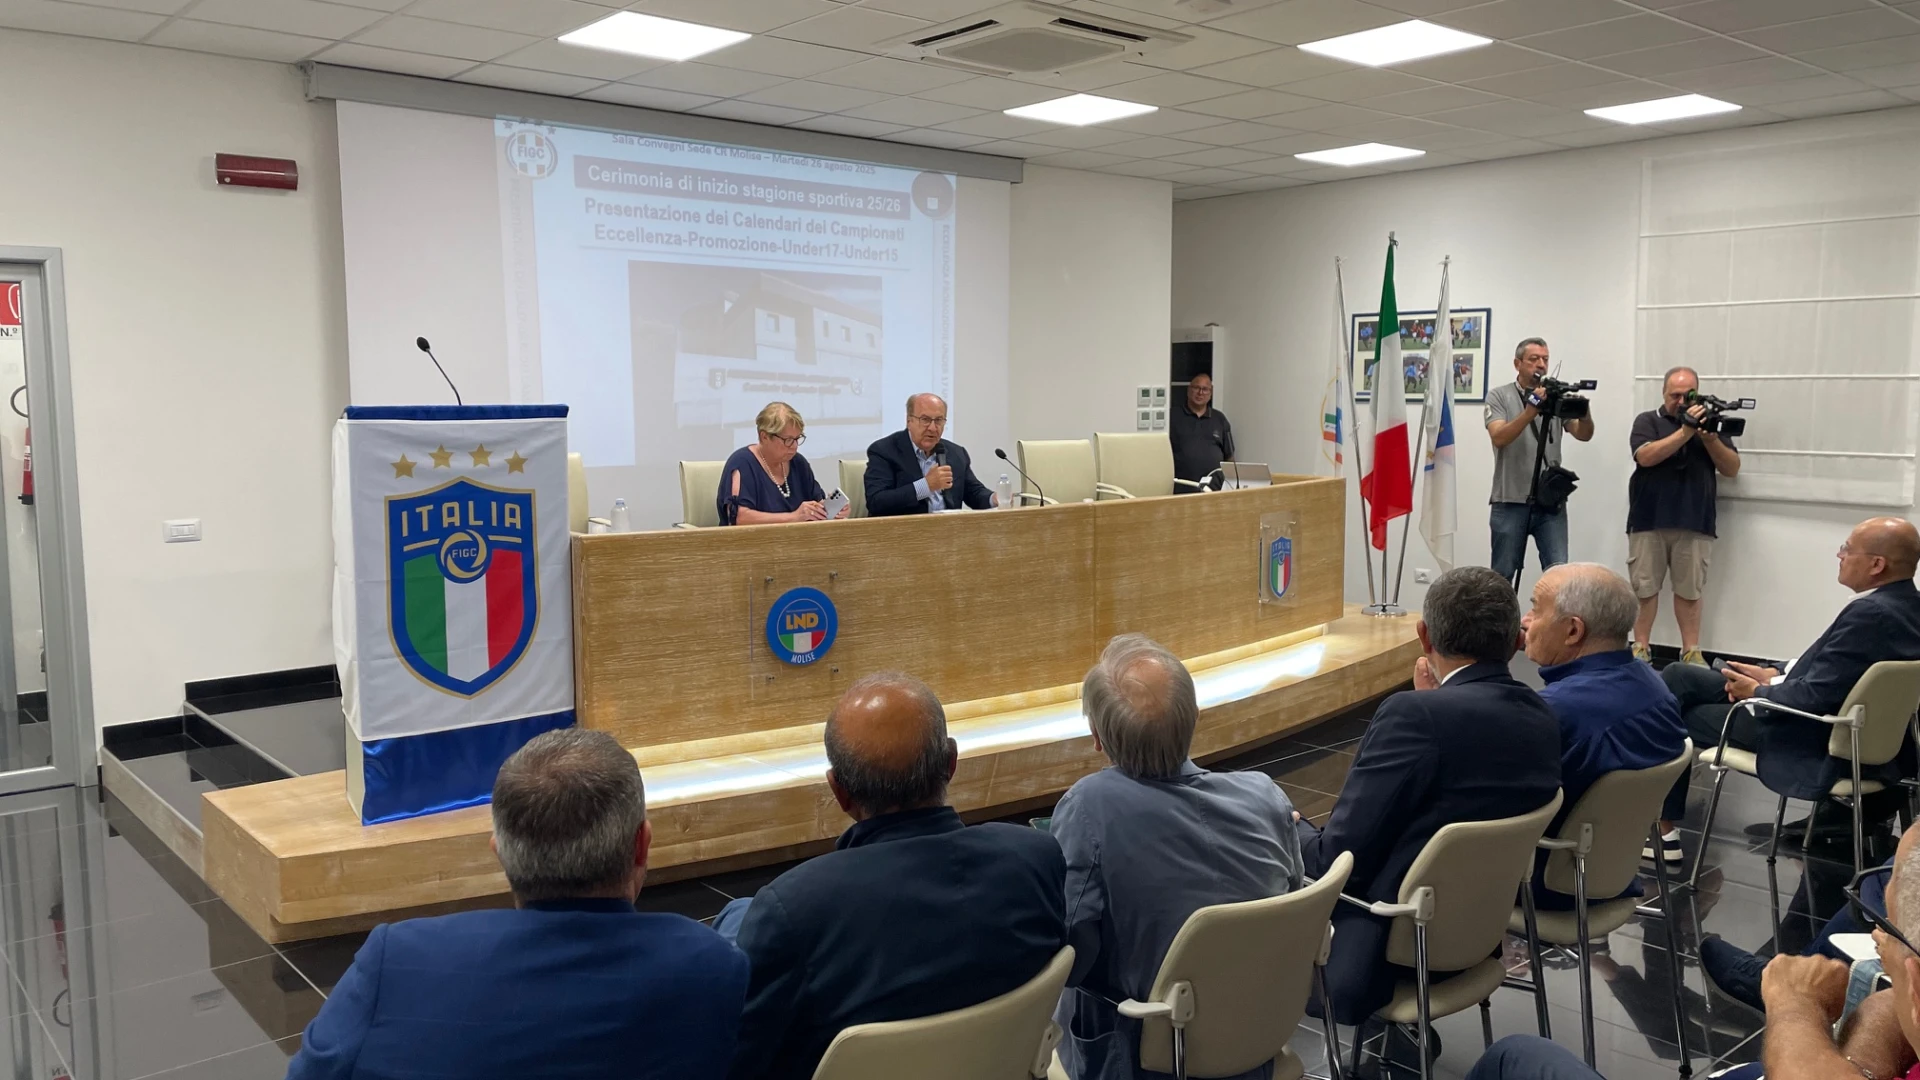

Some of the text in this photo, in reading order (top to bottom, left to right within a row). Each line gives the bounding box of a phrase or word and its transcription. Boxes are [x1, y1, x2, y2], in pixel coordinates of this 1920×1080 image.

[517, 145, 545, 159] FIGC
[612, 134, 635, 146] Sala
[637, 136, 685, 152] Convegni
[687, 143, 712, 155] Sede
[729, 148, 762, 161] Molise
[811, 159, 823, 168] 26
[824, 162, 853, 172] agosto
[855, 164, 876, 175] 2025
[588, 165, 901, 212] Cerimonia di inizio stagione sportiva 25/26
[585, 197, 701, 223] Presentazione
[706, 208, 728, 226] dei
[733, 211, 801, 233] Calendari
[831, 221, 904, 241] Campionati
[594, 223, 898, 262] Eccellenza-Promozione-Under17-Under15
[402, 500, 522, 537] ITALIA
[452, 548, 477, 558] FIGC
[1272, 541, 1290, 553] ITALIA
[786, 612, 819, 630] LND
[790, 651, 816, 664] MOLISE
